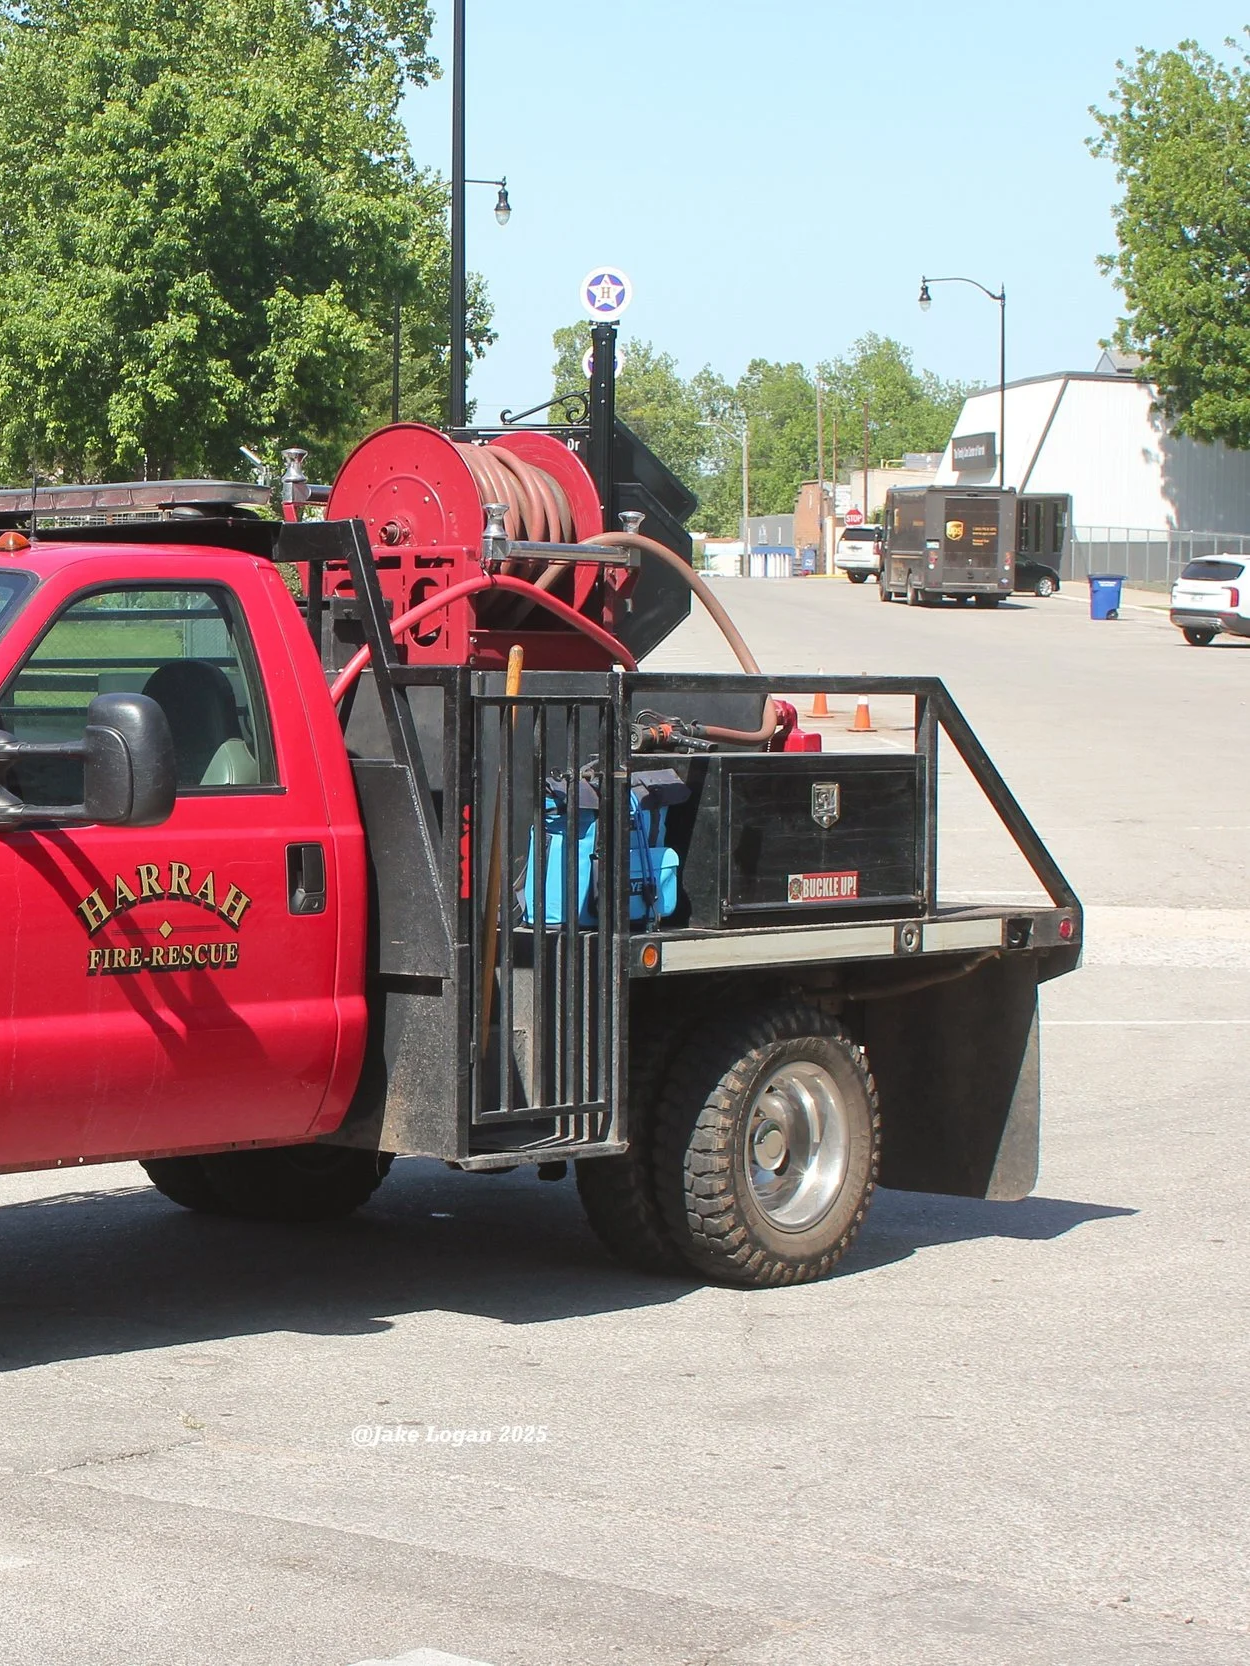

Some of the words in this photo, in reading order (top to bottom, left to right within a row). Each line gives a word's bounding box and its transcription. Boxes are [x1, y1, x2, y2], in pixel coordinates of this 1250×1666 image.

[601, 286, 611, 299] H
[567, 438, 580, 451] Dr
[846, 514, 863, 523] STOP
[803, 877, 839, 898] BUCKLE
[841, 875, 857, 896] UP!
[77, 861, 252, 938] HARRAH
[87, 942, 240, 975] FIRE-RESCUE
